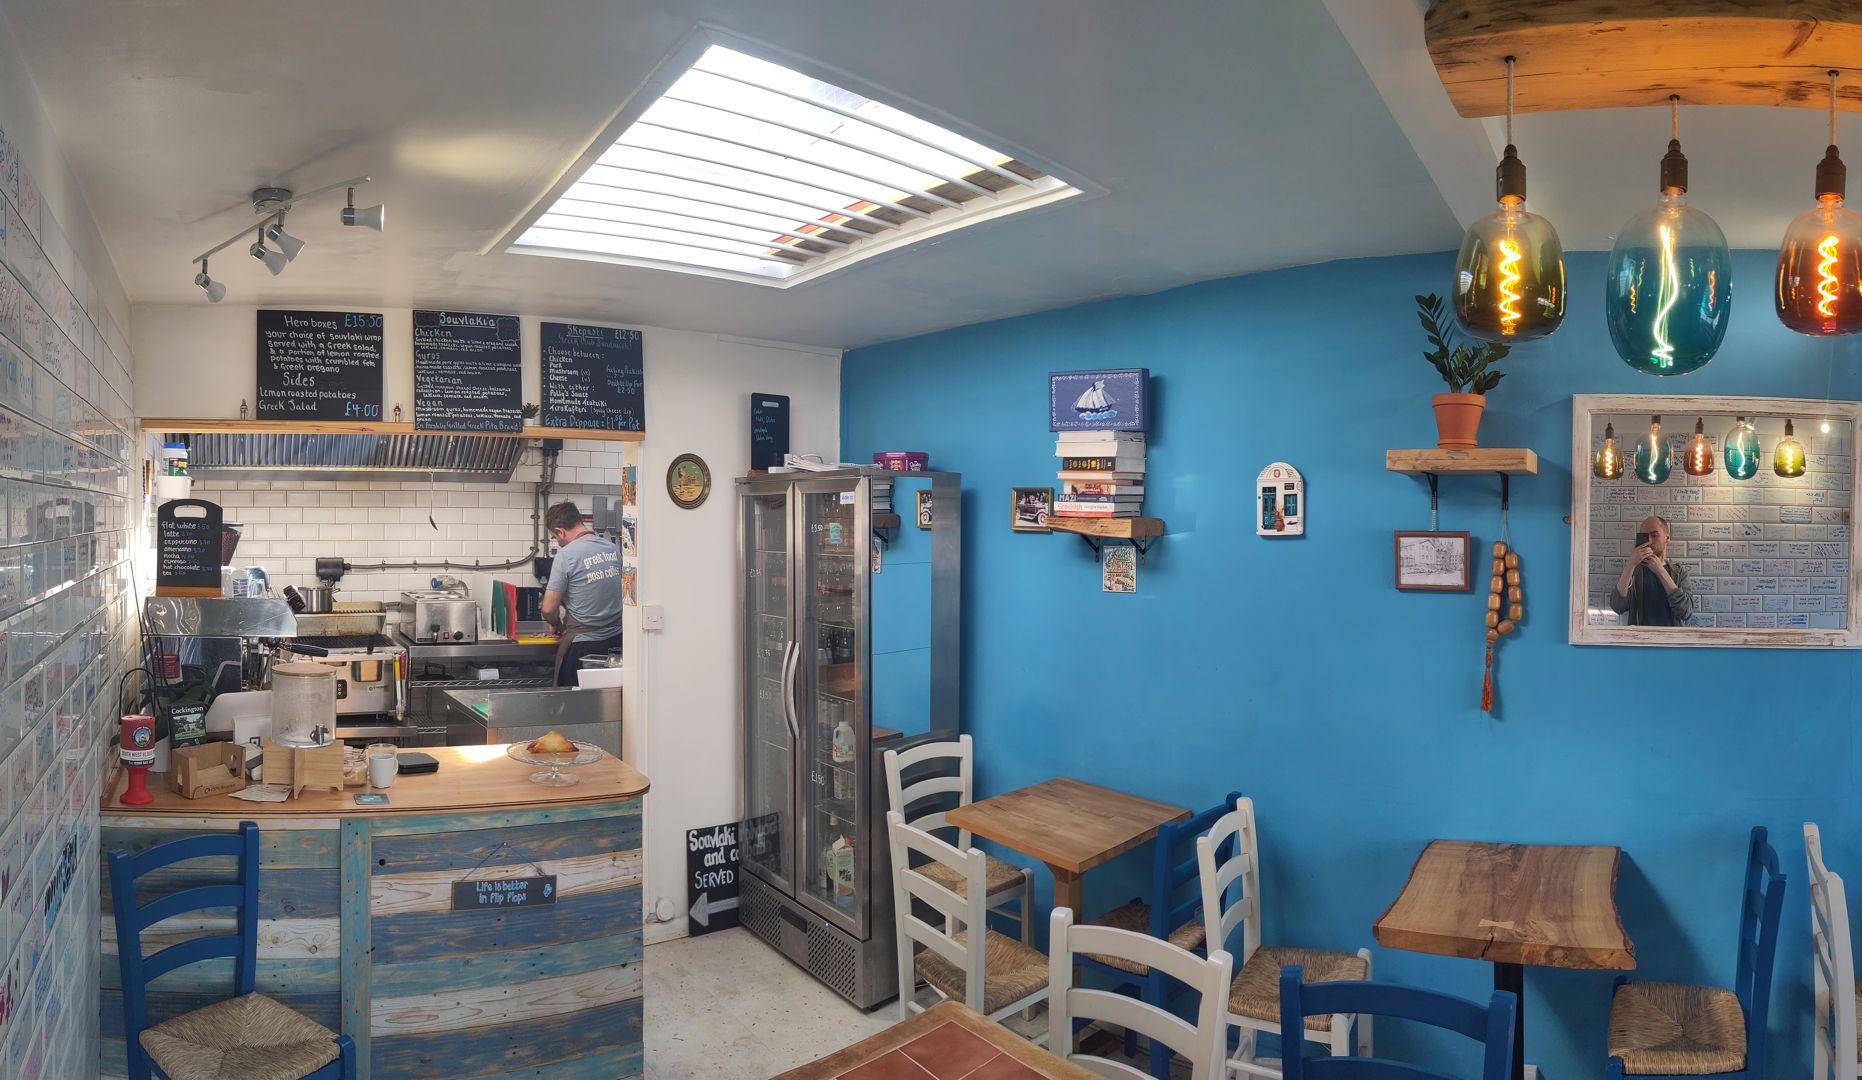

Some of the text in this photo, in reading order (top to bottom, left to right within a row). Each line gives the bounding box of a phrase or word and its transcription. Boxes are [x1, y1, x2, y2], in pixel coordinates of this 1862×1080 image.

[283, 315, 308, 327] Hero
[311, 317, 337, 330] boxes
[289, 330, 314, 340] choice
[317, 332, 326, 340] of
[298, 340, 316, 349] with
[317, 349, 325, 357] of
[305, 356, 323, 364] with
[283, 372, 315, 387] Sides
[288, 389, 318, 398] roasted
[319, 390, 357, 400] potatoes
[416, 400, 444, 411] Vegan
[545, 413, 567, 428] Extra
[629, 416, 640, 430] Pot
[1059, 494, 1077, 502] MAZI
[177, 521, 197, 530] white
[171, 705, 204, 715] Cockington
[689, 826, 736, 851] Souvlaki
[704, 847, 726, 867] and
[476, 880, 529, 892] Life is better
